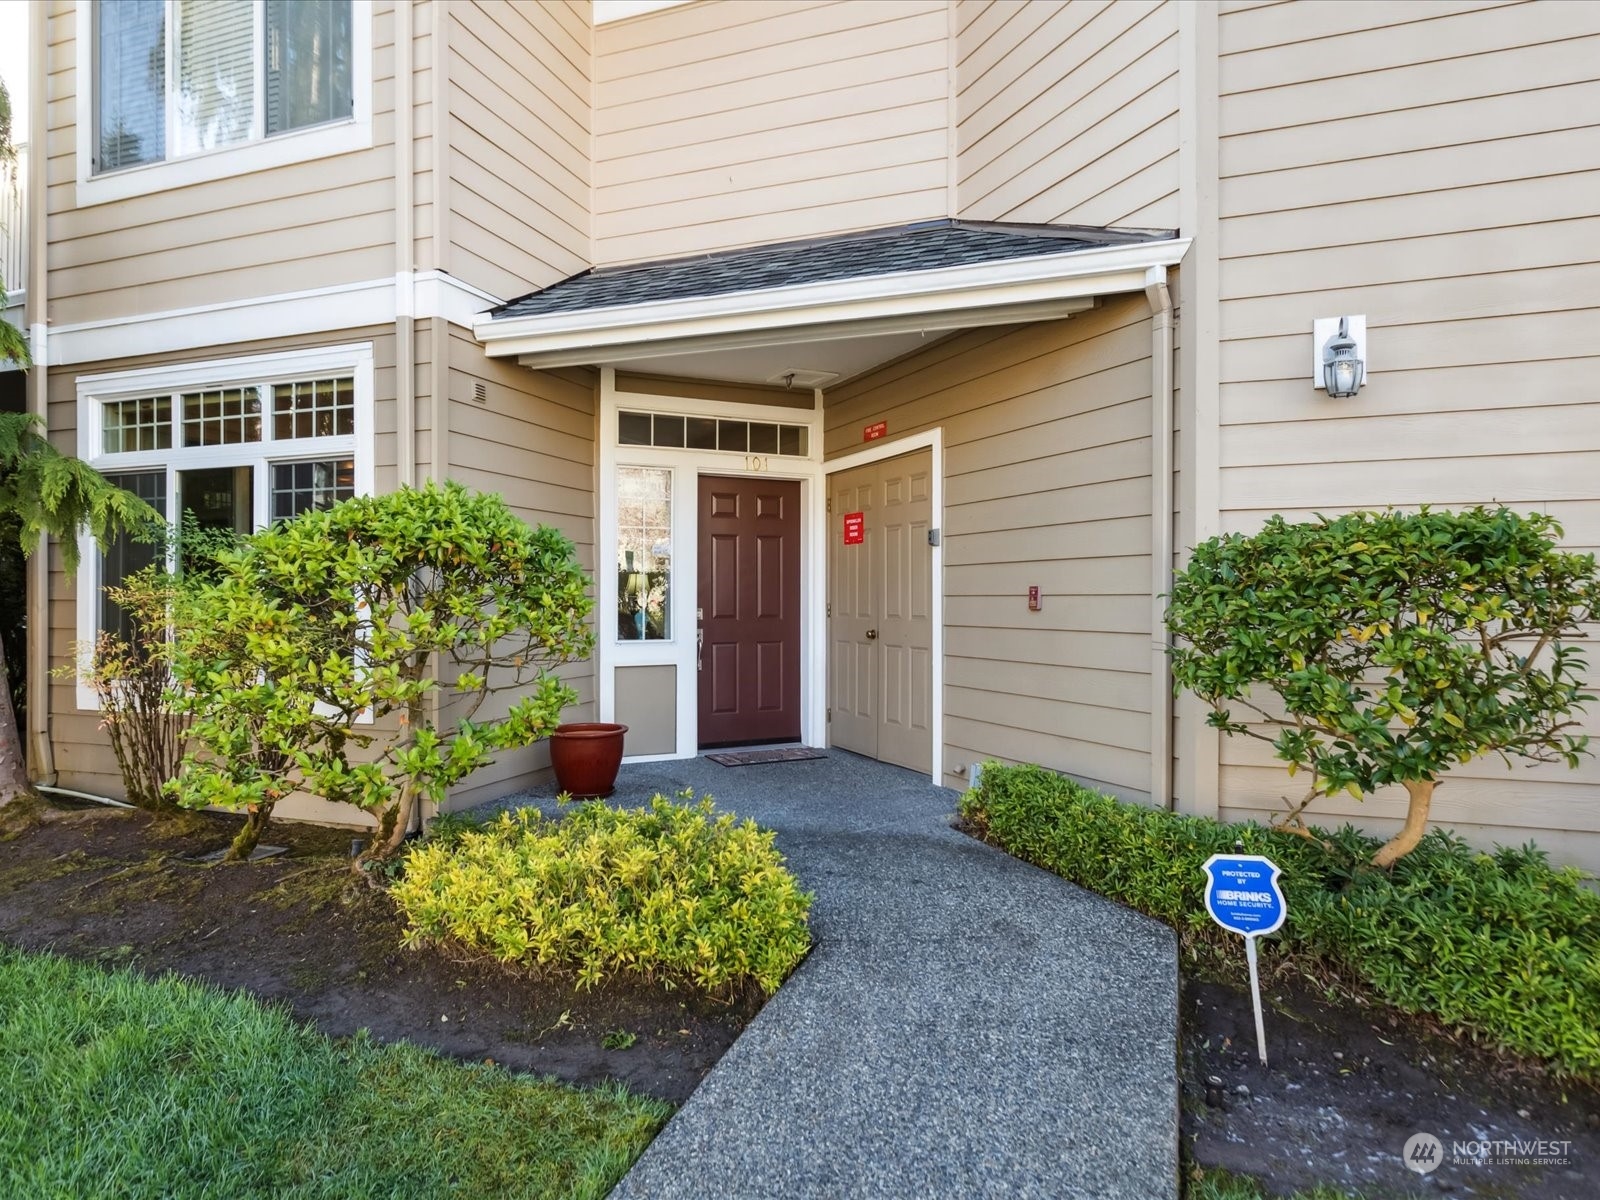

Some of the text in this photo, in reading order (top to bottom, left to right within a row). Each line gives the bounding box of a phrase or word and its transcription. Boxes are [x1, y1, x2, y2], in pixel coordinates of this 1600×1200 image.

[744, 455, 769, 472] 101
[1221, 870, 1261, 878] PROTECTED
[1225, 890, 1272, 902] BRINKS
